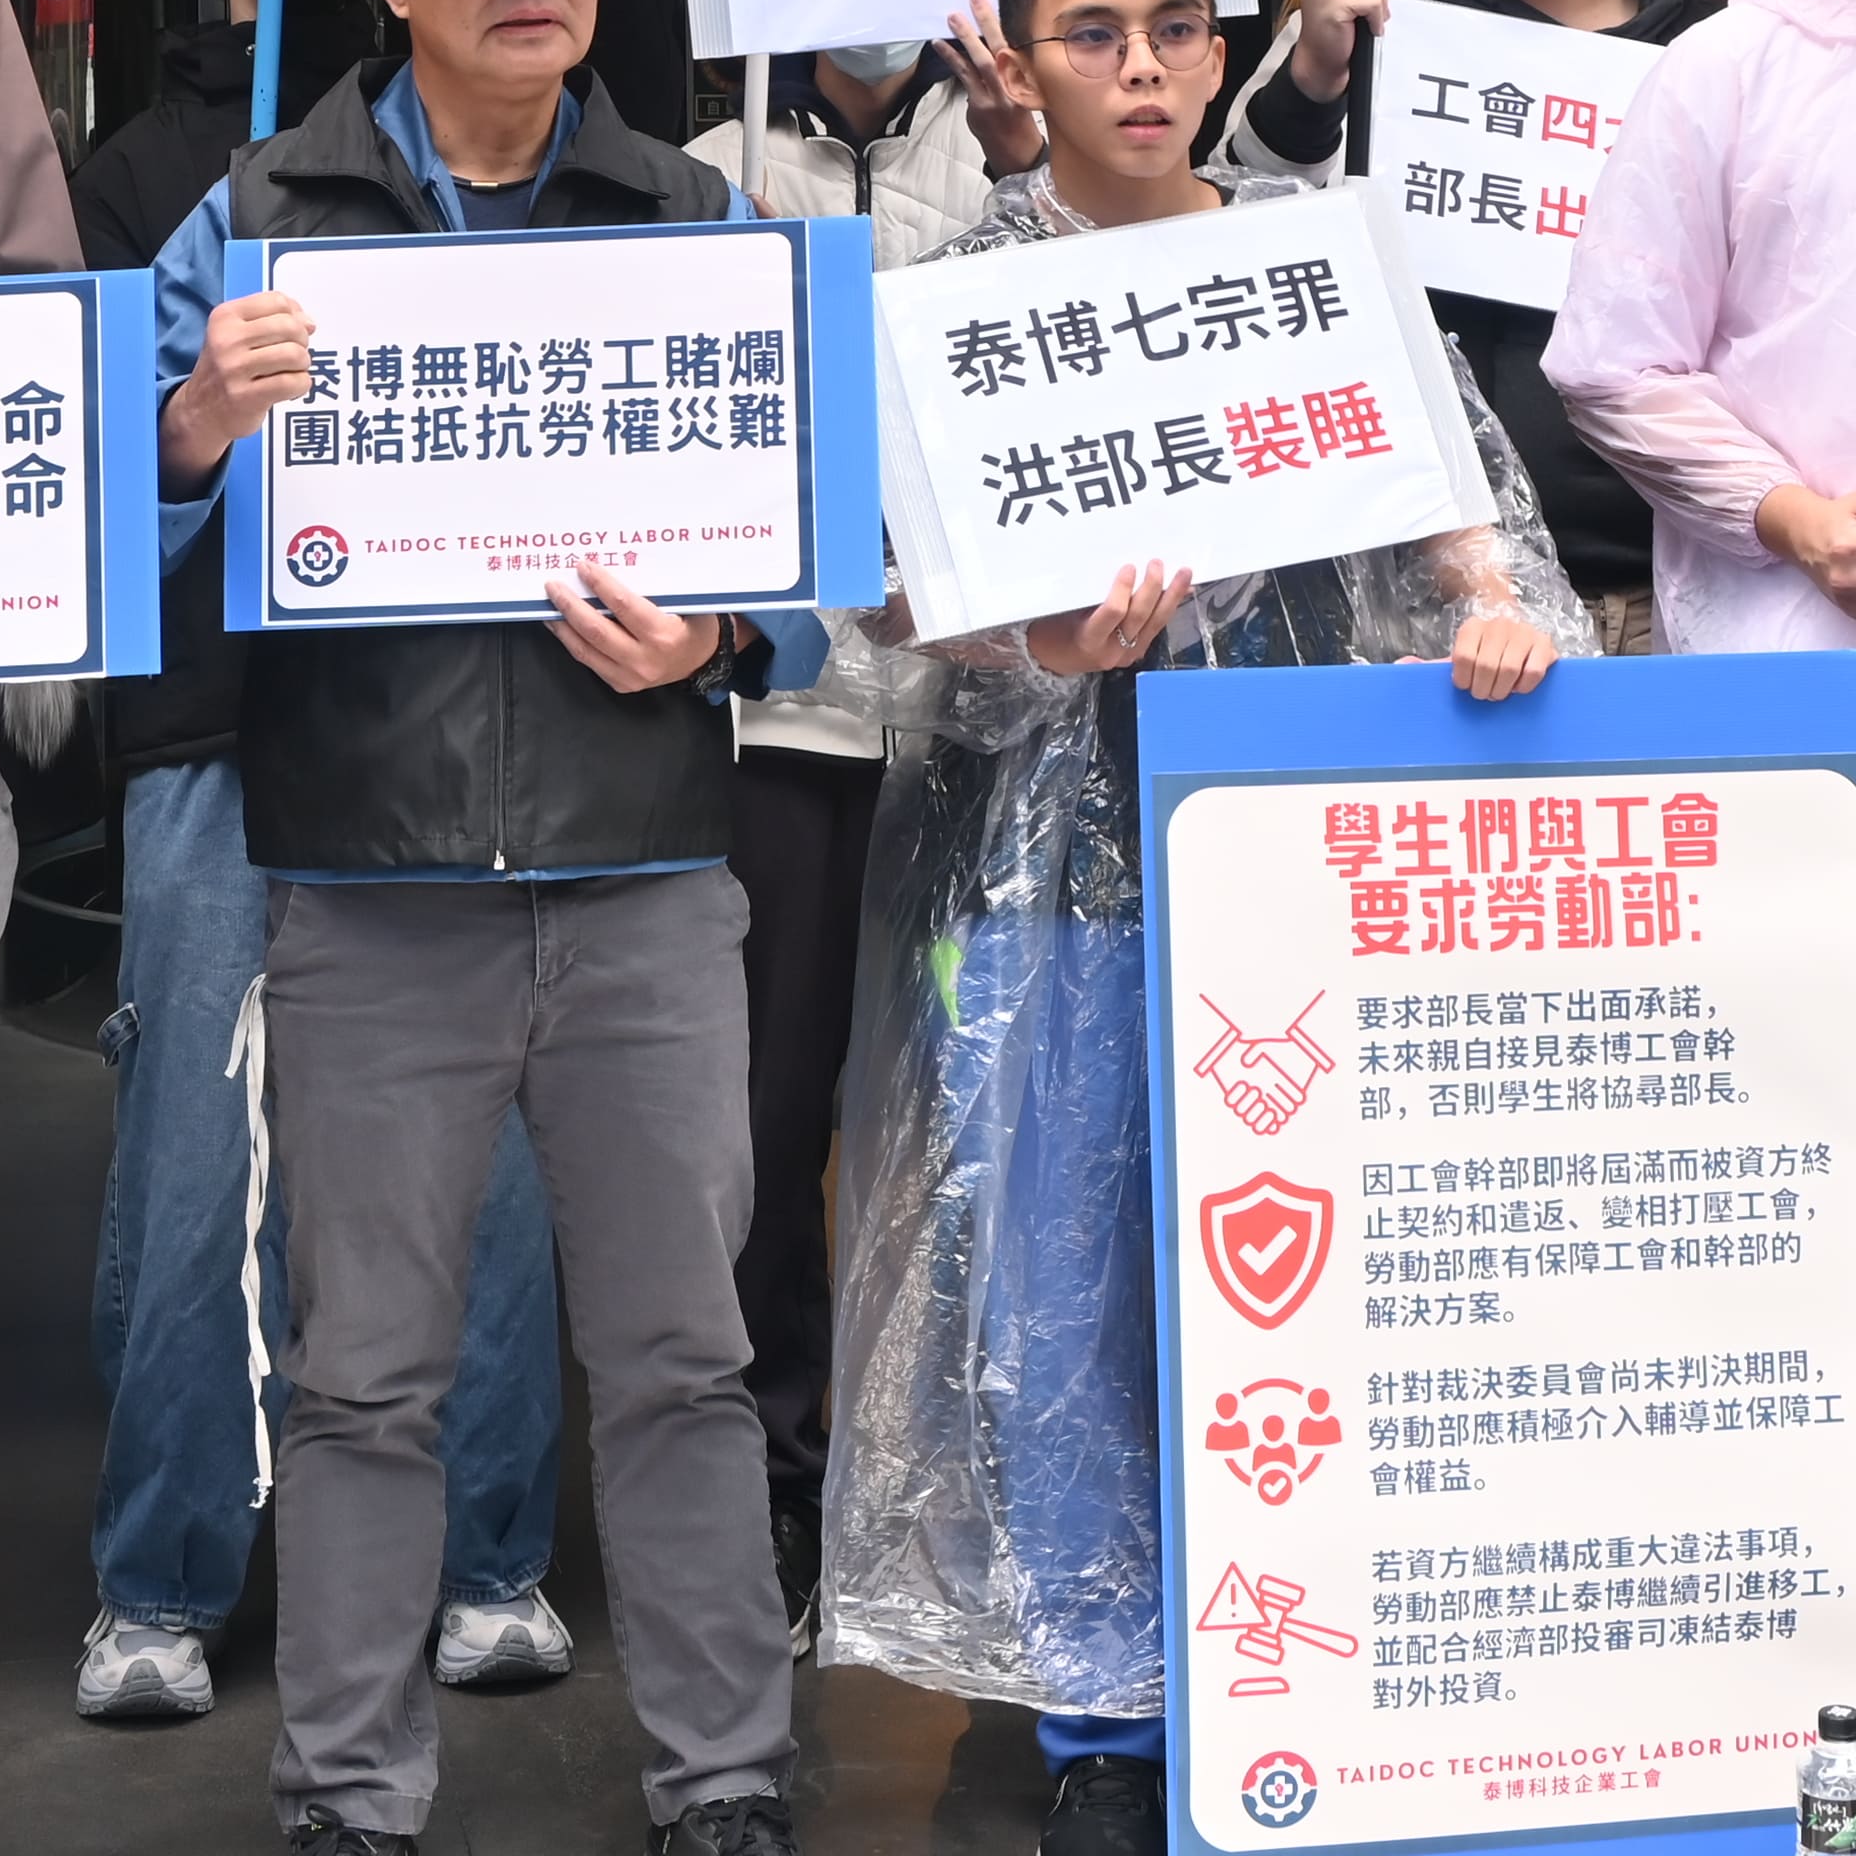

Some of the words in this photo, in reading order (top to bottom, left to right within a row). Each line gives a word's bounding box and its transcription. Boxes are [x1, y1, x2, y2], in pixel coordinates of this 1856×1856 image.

[945, 257, 1350, 397] 泰博七宗罪
[290, 329, 786, 405] 泰博無恥勞工賭爛
[283, 393, 787, 467] 團結抵抗勞權災難
[980, 380, 1393, 529] 洪部長裝睡
[364, 537, 447, 554] TAIDOC
[457, 530, 609, 549] TECHNOLOGY
[618, 526, 691, 544] LABOR
[700, 523, 774, 541] UNION
[1323, 792, 1719, 878] 學生們與工會
[1350, 871, 1701, 957] 要求勞動部:
[1356, 984, 1719, 1030] 要求部長當下出面承諾，
[1357, 1029, 1736, 1076] 未來親自接見泰博工會幹
[1359, 1074, 1751, 1121] 部，否則學生將協尋部長。
[1362, 1142, 1833, 1197] 因工會幹部即將屆滿而被資方終
[1364, 1231, 1803, 1286] 勞動部應有保障工會和幹部的
[1365, 1291, 1517, 1331] 解決方案。
[1367, 1350, 1828, 1406] 針對裁決委員會尚未判決期間，
[1368, 1395, 1845, 1452] 勞動部應積極介入輔導並保障工
[1371, 1459, 1489, 1499] 會權益。
[1372, 1526, 1817, 1584] 若資方繼續構成重大違法事項，
[1372, 1569, 1849, 1626] 勞動部應禁止泰博繼續引進移工，
[1372, 1607, 1799, 1669] 並配合經濟部投審司凍結泰博
[1372, 1670, 1520, 1710] 對外投資。
[1337, 1761, 1435, 1784] TAIDOC
[1448, 1745, 1628, 1774] TECHNOLOGY
[1639, 1737, 1724, 1760] LABOR
[1734, 1729, 1818, 1752] UNION
[1482, 1768, 1663, 1801] 泰博科技企業工會
